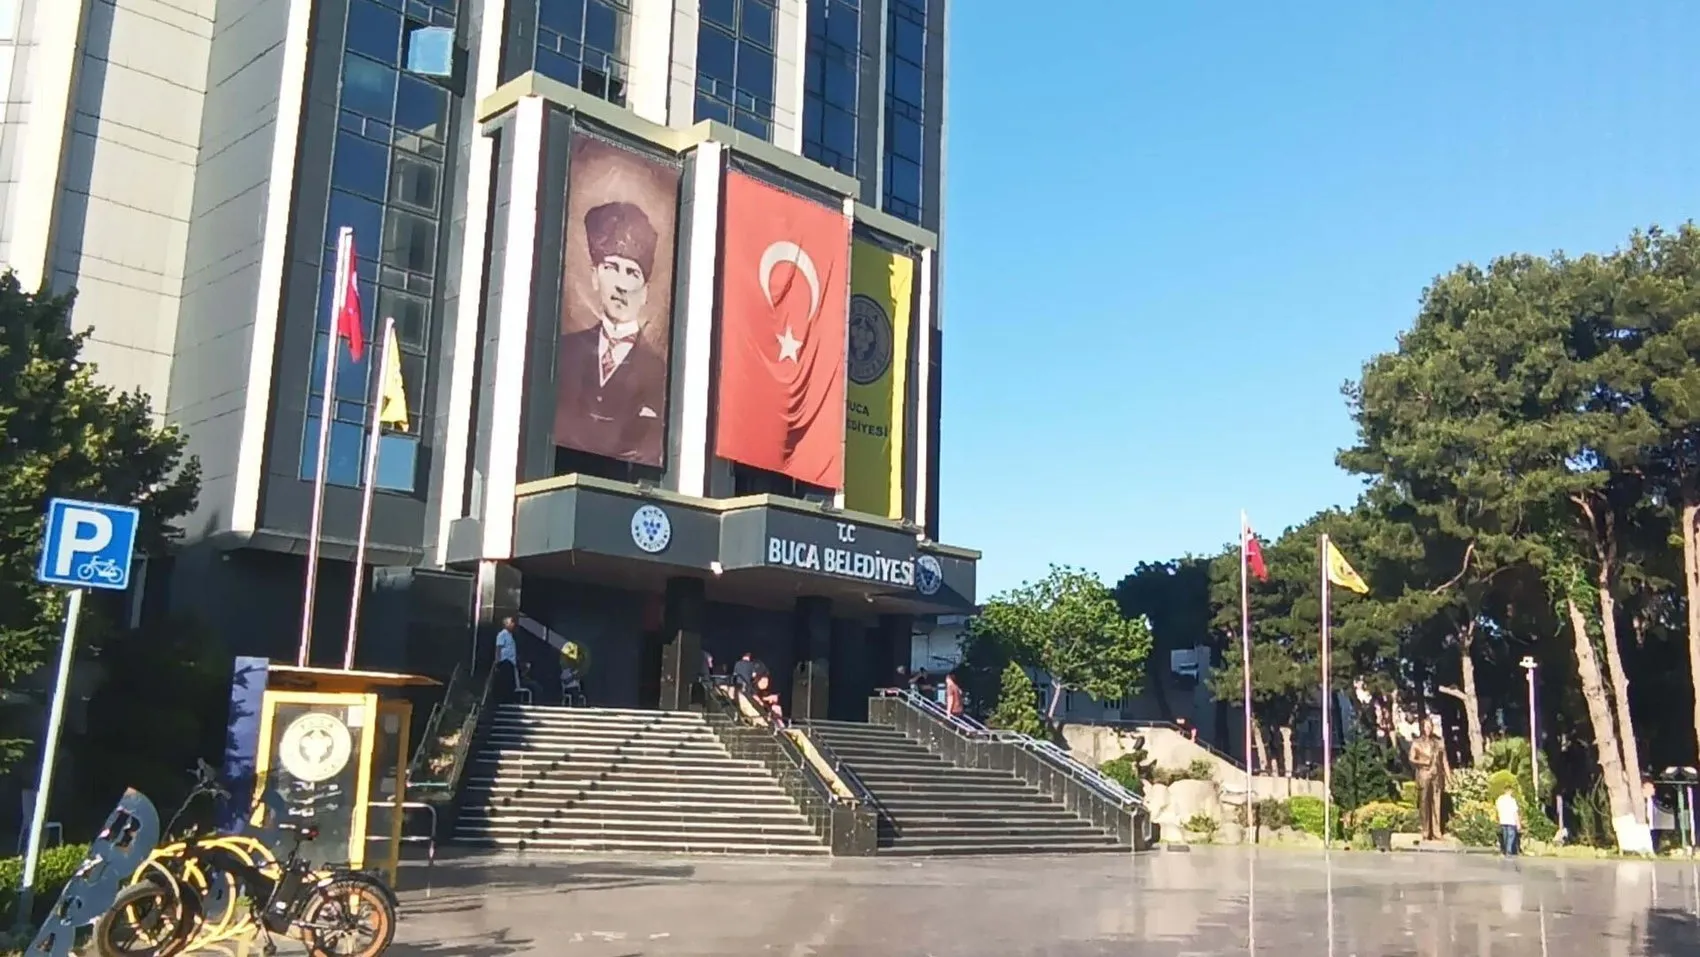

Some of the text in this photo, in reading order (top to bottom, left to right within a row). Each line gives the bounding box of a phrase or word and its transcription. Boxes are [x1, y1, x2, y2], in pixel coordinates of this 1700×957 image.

[847, 400, 870, 417] UCA
[55, 507, 113, 576] P
[768, 537, 820, 571] BUCA
[824, 548, 915, 586] BELEDİYESİ
